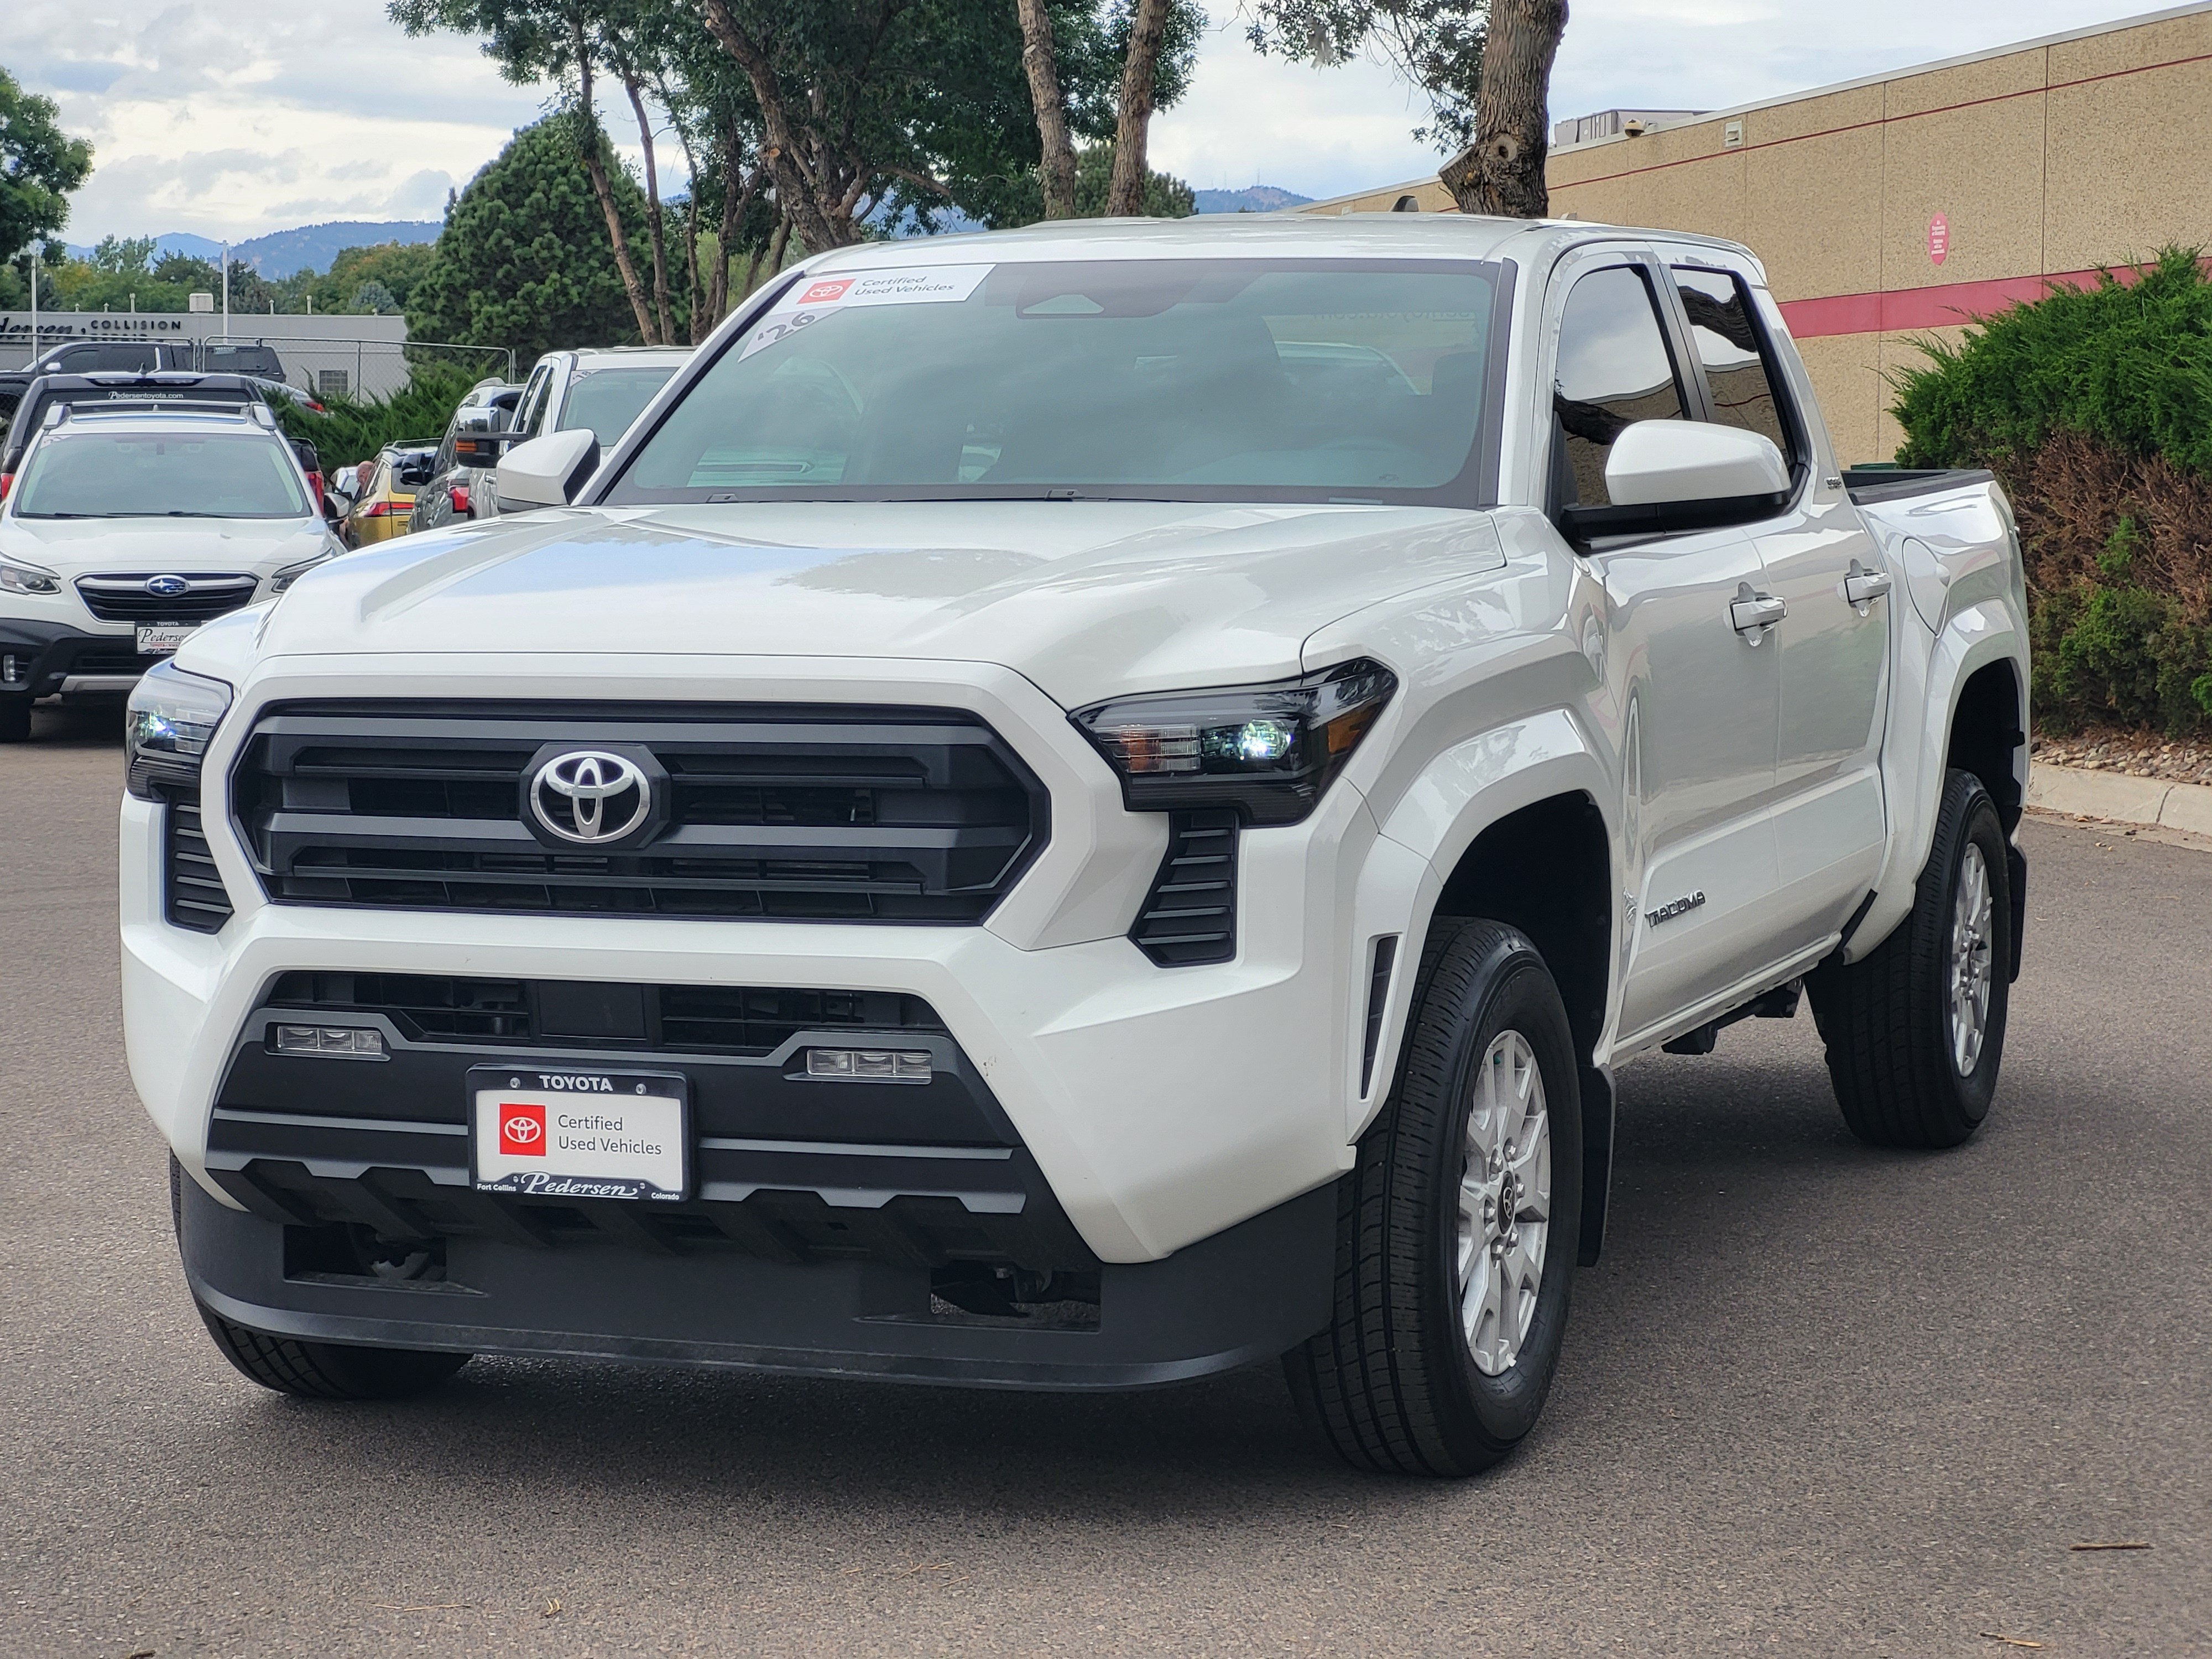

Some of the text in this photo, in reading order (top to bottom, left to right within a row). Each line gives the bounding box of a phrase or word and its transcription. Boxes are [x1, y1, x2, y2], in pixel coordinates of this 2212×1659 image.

[854, 283, 954, 296] Used Vehicles
[862, 276, 927, 286] Certified
[91, 320, 181, 330] COLLISION
[758, 312, 816, 341] '26
[108, 391, 184, 400] Pedersentoyota.com
[138, 628, 185, 643] Pederse
[1645, 888, 1706, 928] TACOMA
[539, 1074, 613, 1092] TOYOTA
[557, 1114, 623, 1131] Certified
[558, 1136, 662, 1155] Used Vehicles
[520, 1171, 638, 1198] Pedersen
